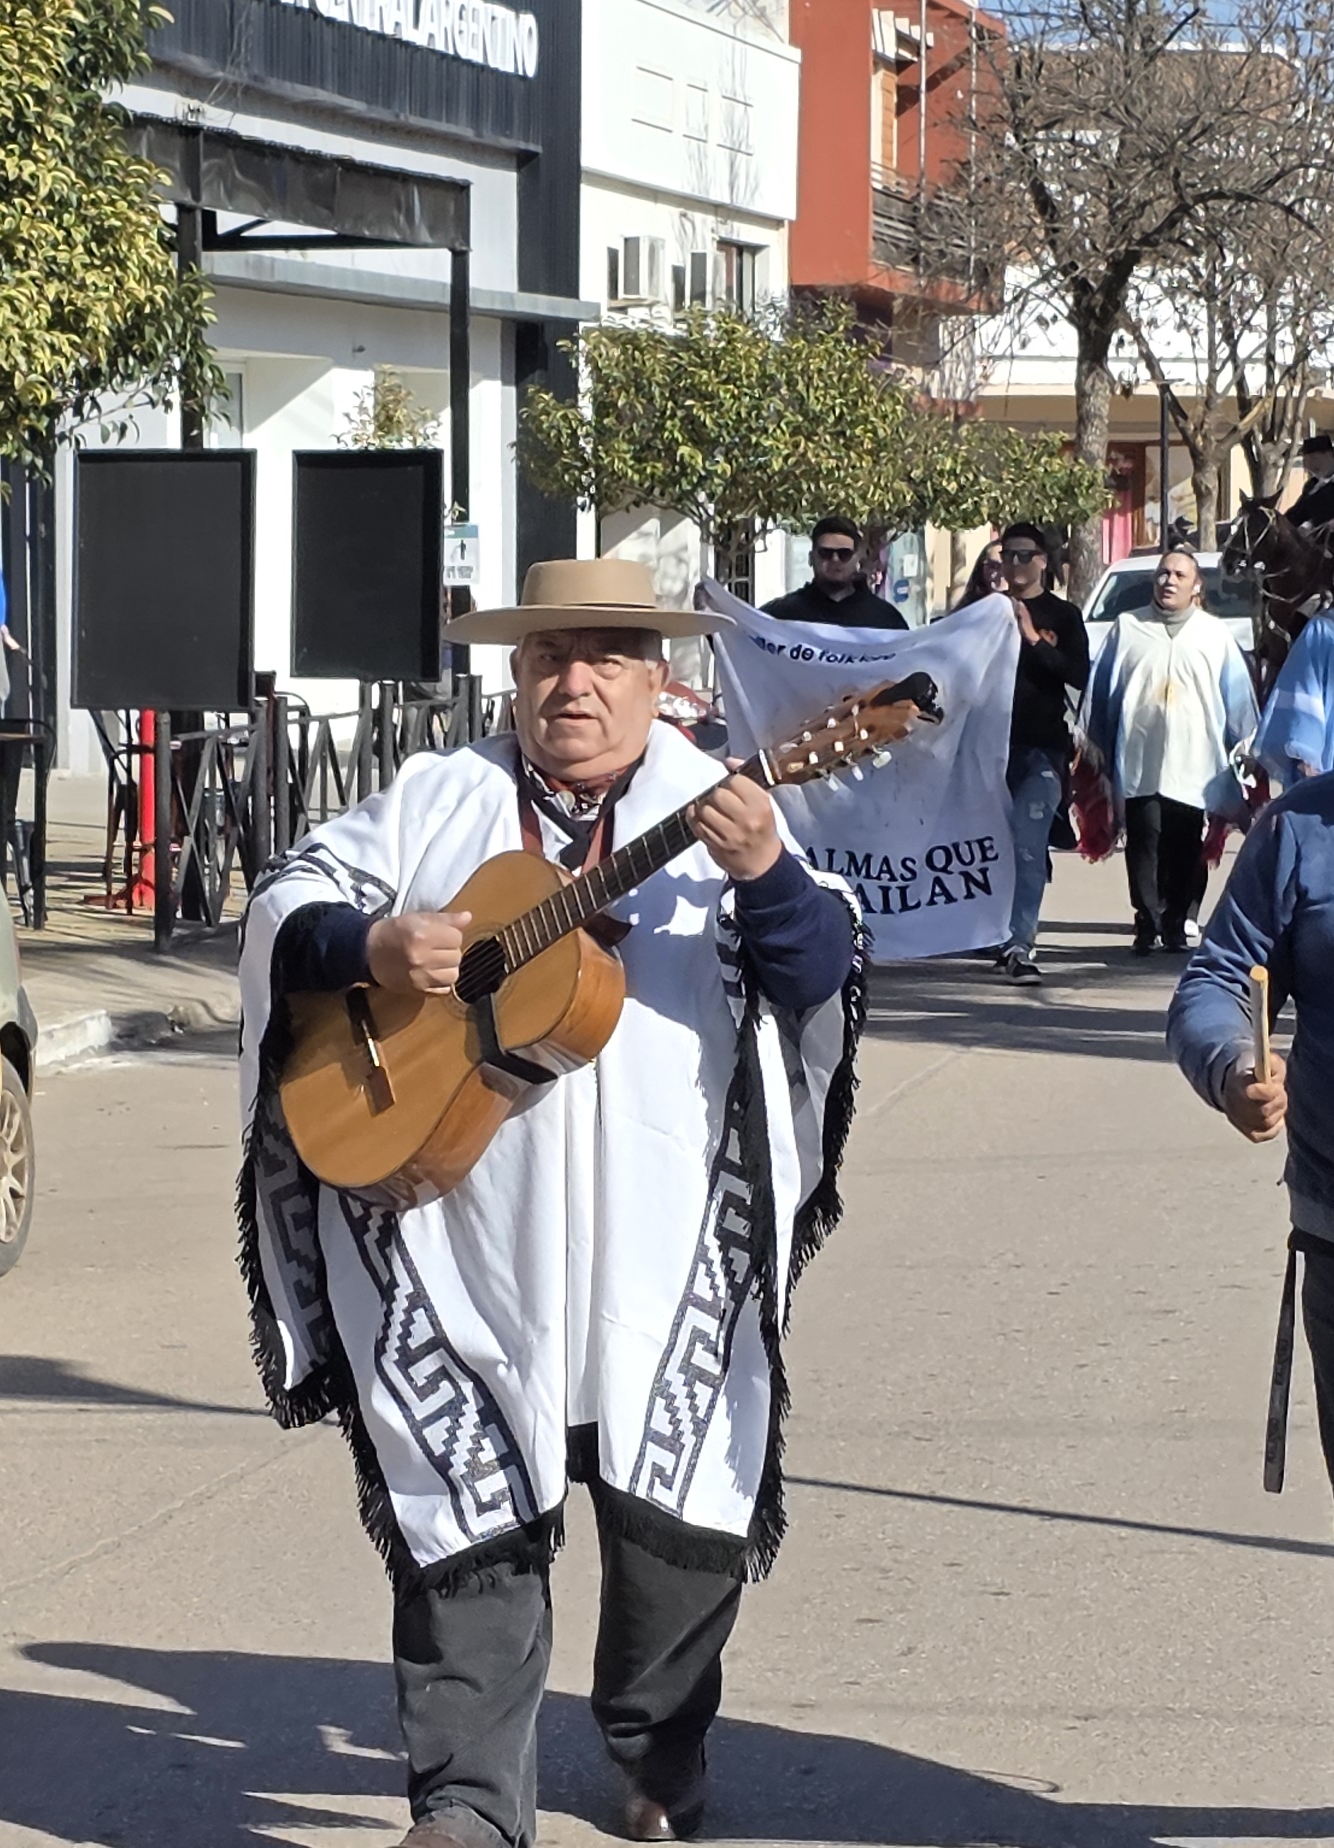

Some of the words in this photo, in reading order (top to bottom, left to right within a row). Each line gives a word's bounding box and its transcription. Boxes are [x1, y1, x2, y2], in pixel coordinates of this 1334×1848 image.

[790, 644, 814, 661] de
[806, 846, 917, 882] ALMAS
[925, 836, 999, 874] QUE
[854, 867, 992, 914] AILAN
